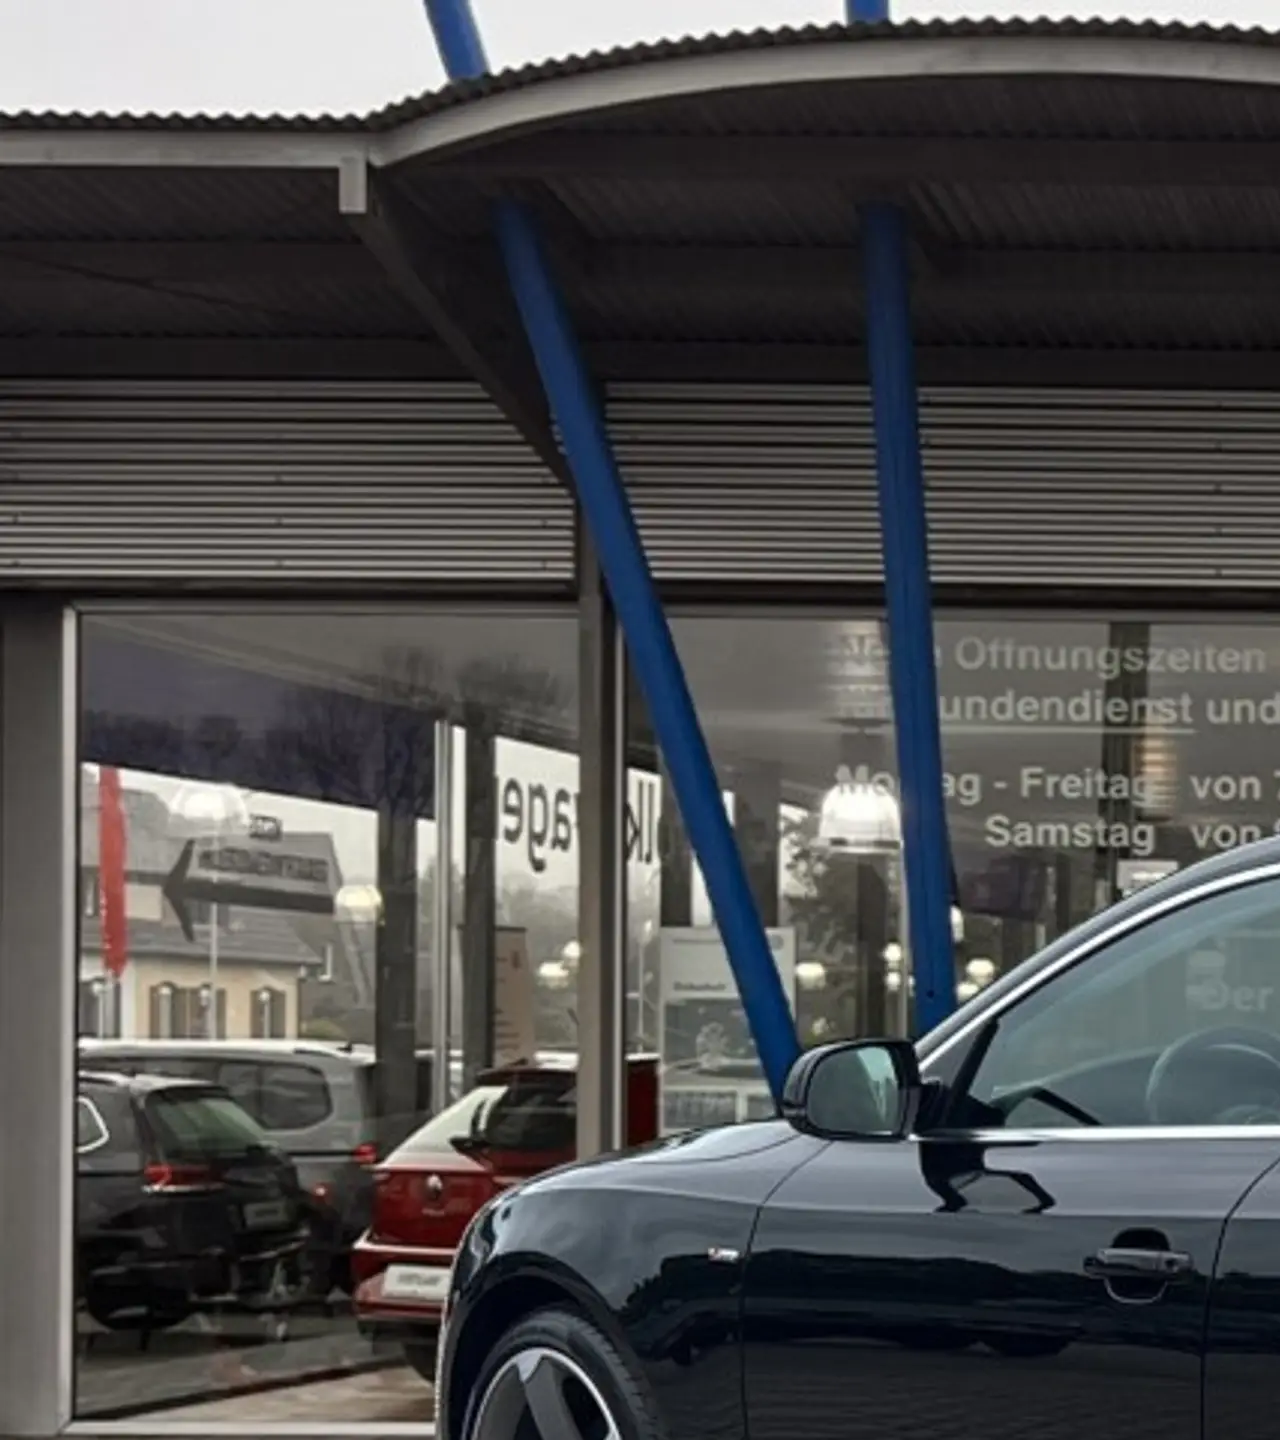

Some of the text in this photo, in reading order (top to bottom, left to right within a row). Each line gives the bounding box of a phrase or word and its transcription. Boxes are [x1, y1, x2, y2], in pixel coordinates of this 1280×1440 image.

[939, 689, 1194, 723] undendienst
[835, 764, 982, 806] Moag
[1020, 766, 1155, 809] Freitag
[1190, 774, 1262, 800] von
[985, 814, 1155, 856] Samstag
